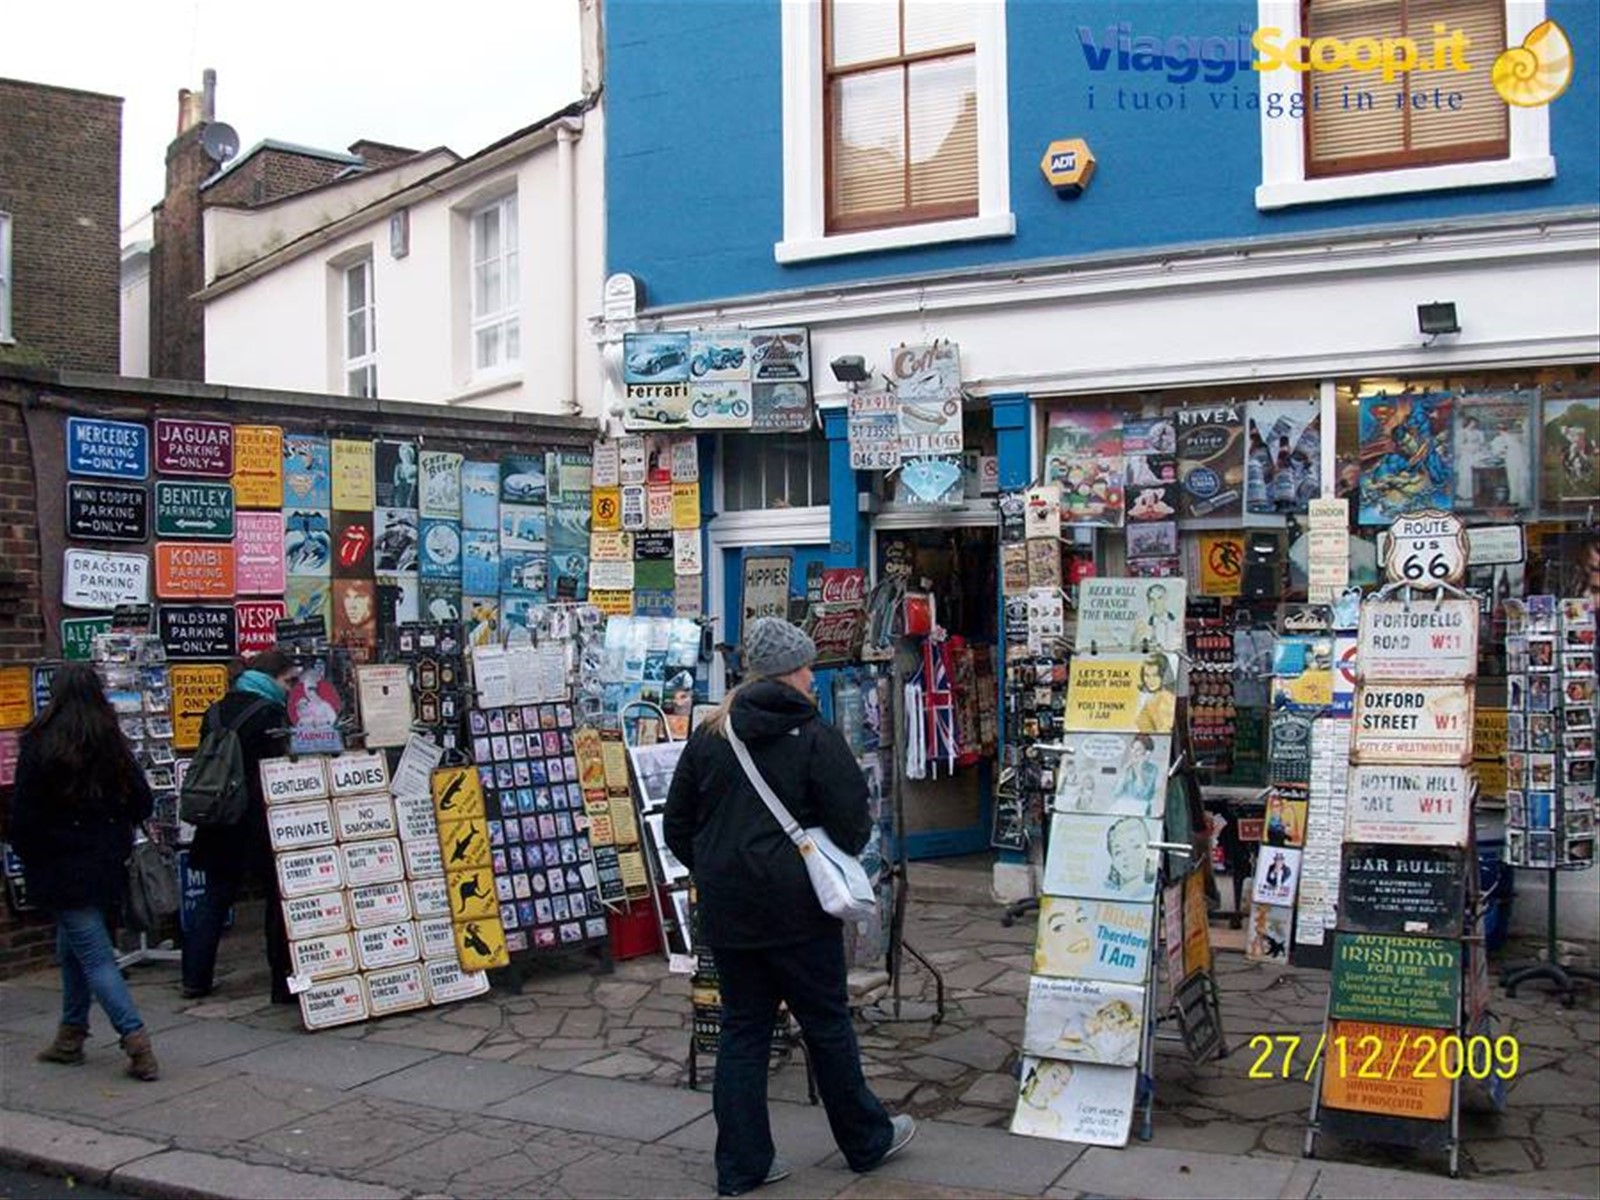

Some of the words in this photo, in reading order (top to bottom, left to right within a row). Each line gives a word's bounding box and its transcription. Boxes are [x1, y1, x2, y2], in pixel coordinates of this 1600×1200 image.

[1052, 154, 1077, 170] ADT
[626, 382, 689, 398] Ferrari
[1178, 407, 1240, 426] NIVEA
[76, 425, 139, 447] MERCEDES
[159, 426, 230, 446] JAGUAR
[81, 443, 135, 459] PARKING
[169, 442, 221, 458] PARKING
[93, 457, 124, 470] ONLY
[180, 456, 210, 469] ONLY
[73, 486, 98, 501] MINI
[100, 490, 143, 506] COOPER
[162, 486, 227, 507] BENTLEY
[81, 503, 136, 519] PARKING
[159, 504, 203, 518] PARKING
[205, 506, 232, 520] ONLY
[93, 520, 124, 533] ONLY
[1403, 521, 1450, 535] ROUTE
[243, 542, 274, 554] ONLY
[170, 548, 223, 566] KOMBI
[73, 558, 141, 575] DRAGSTAR
[170, 566, 224, 579] PARKING
[1402, 553, 1450, 580] 66
[80, 573, 134, 590] PARKING
[181, 579, 212, 591] ONLY
[746, 567, 788, 588] HIPPIES
[90, 588, 122, 603] ONLY
[167, 612, 228, 625] WILDSTAR
[238, 607, 282, 629] VESPA
[1373, 613, 1464, 629] PORTOBELLO
[171, 626, 225, 639] PARKING
[239, 632, 277, 644] PARKIN
[183, 640, 214, 653] ONLY
[1372, 634, 1411, 650] ROAD
[1364, 692, 1425, 709] OXFORD
[1362, 714, 1419, 730] STREET
[1435, 713, 1458, 730] W1
[271, 776, 321, 795] GENTLEMEN
[335, 768, 384, 787] LADIES
[1360, 773, 1421, 791] NOTTING
[1426, 774, 1459, 792] HILL
[1419, 796, 1453, 814] W11
[358, 807, 374, 820] NO
[276, 820, 329, 839] PRIVATE
[344, 818, 391, 835] SMOKING
[286, 867, 312, 880] STREET
[1349, 858, 1389, 873] BAR
[289, 898, 321, 911] COVENT
[292, 909, 324, 922] GARDEN
[1098, 924, 1149, 949] Therefore
[1355, 933, 1444, 951] AUTHENTIC
[298, 941, 326, 955] BAKER
[1100, 943, 1109, 962] I
[1108, 946, 1136, 969] Am
[300, 950, 331, 964] STREET
[1367, 962, 1394, 974] FOR
